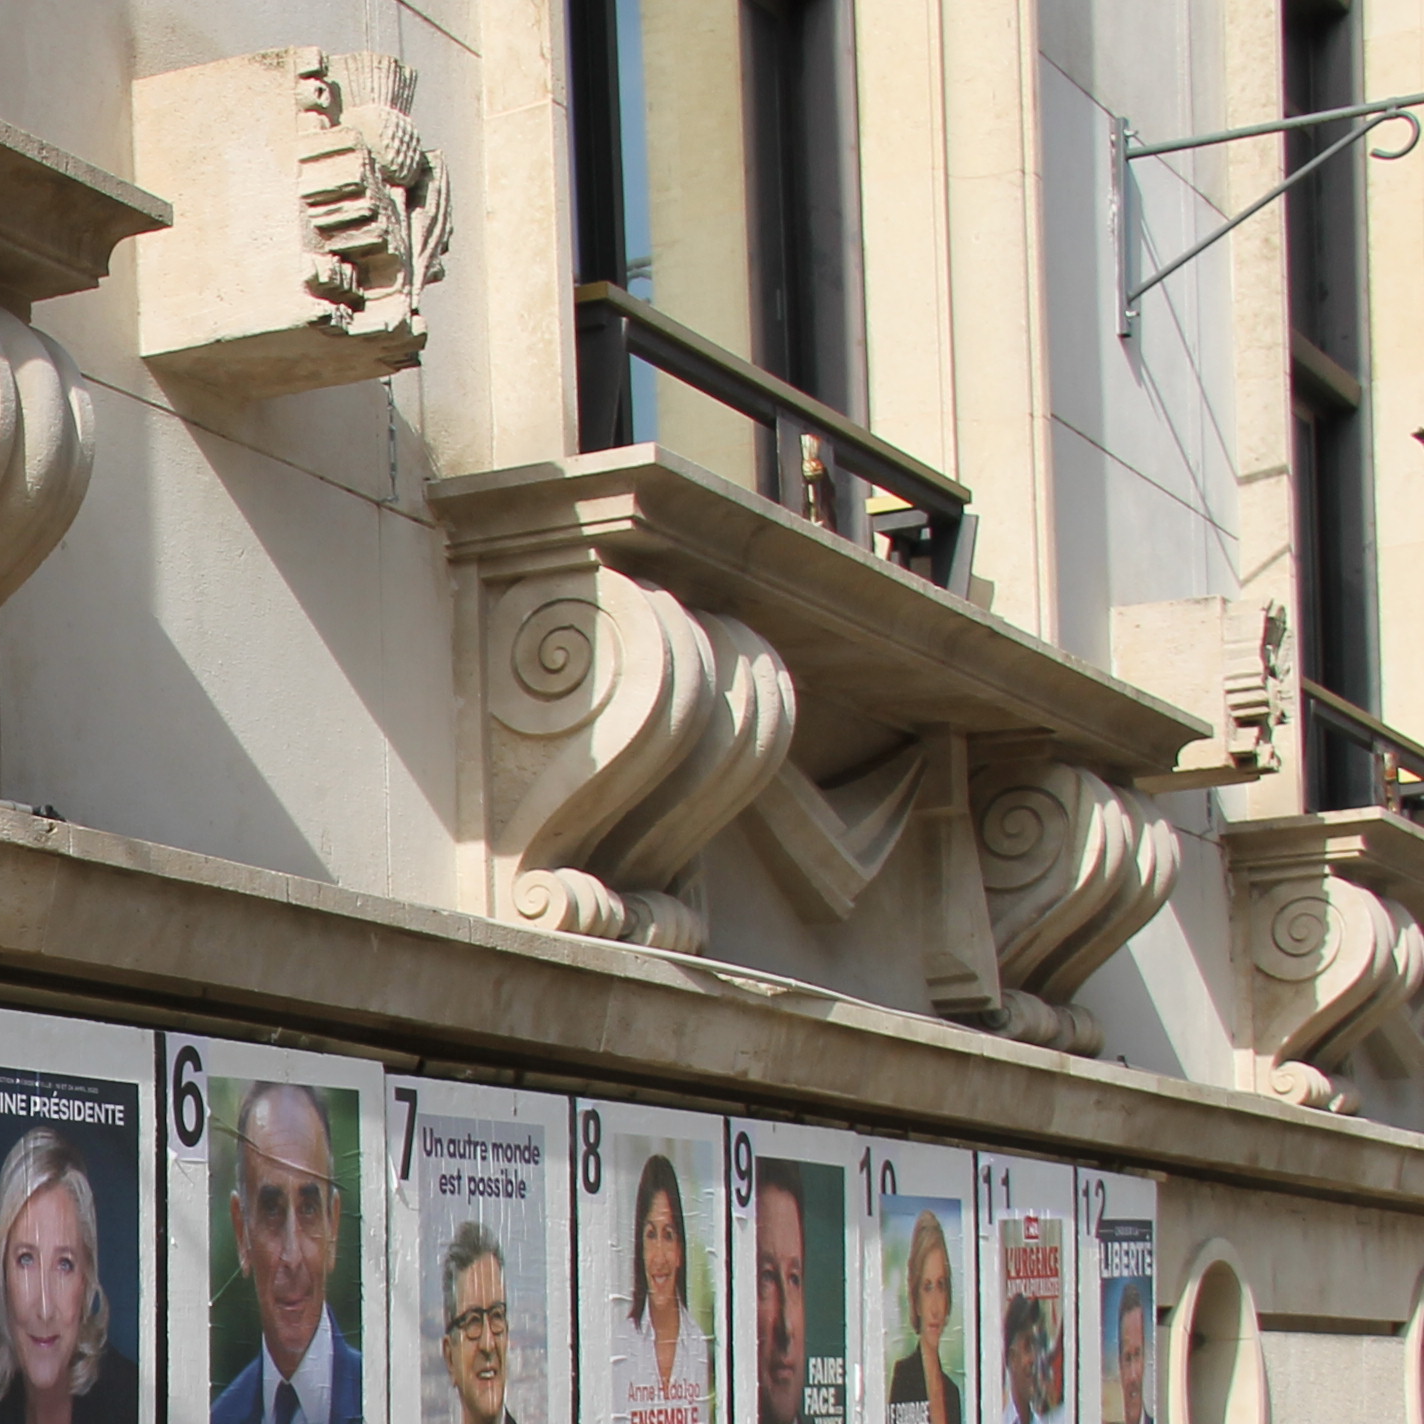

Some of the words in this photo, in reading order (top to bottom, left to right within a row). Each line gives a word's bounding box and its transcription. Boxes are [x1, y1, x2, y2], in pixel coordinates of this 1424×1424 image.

[30, 1091, 124, 1126] PRÉSIDENTE
[172, 1045, 204, 1148] 6
[394, 1087, 417, 1181] 7
[423, 1127, 443, 1158] Un
[447, 1132, 487, 1162] autre
[492, 1135, 540, 1166] monde
[582, 1109, 601, 1195] 8
[439, 1171, 462, 1196] est
[468, 1168, 526, 1204] possible
[734, 1131, 751, 1208] 9
[982, 1164, 1010, 1225] 11
[1082, 1179, 1106, 1238] 12
[627, 1380, 656, 1403] Anne
[658, 1376, 701, 1405] Hidalgo
[808, 1356, 844, 1385] FAIRE
